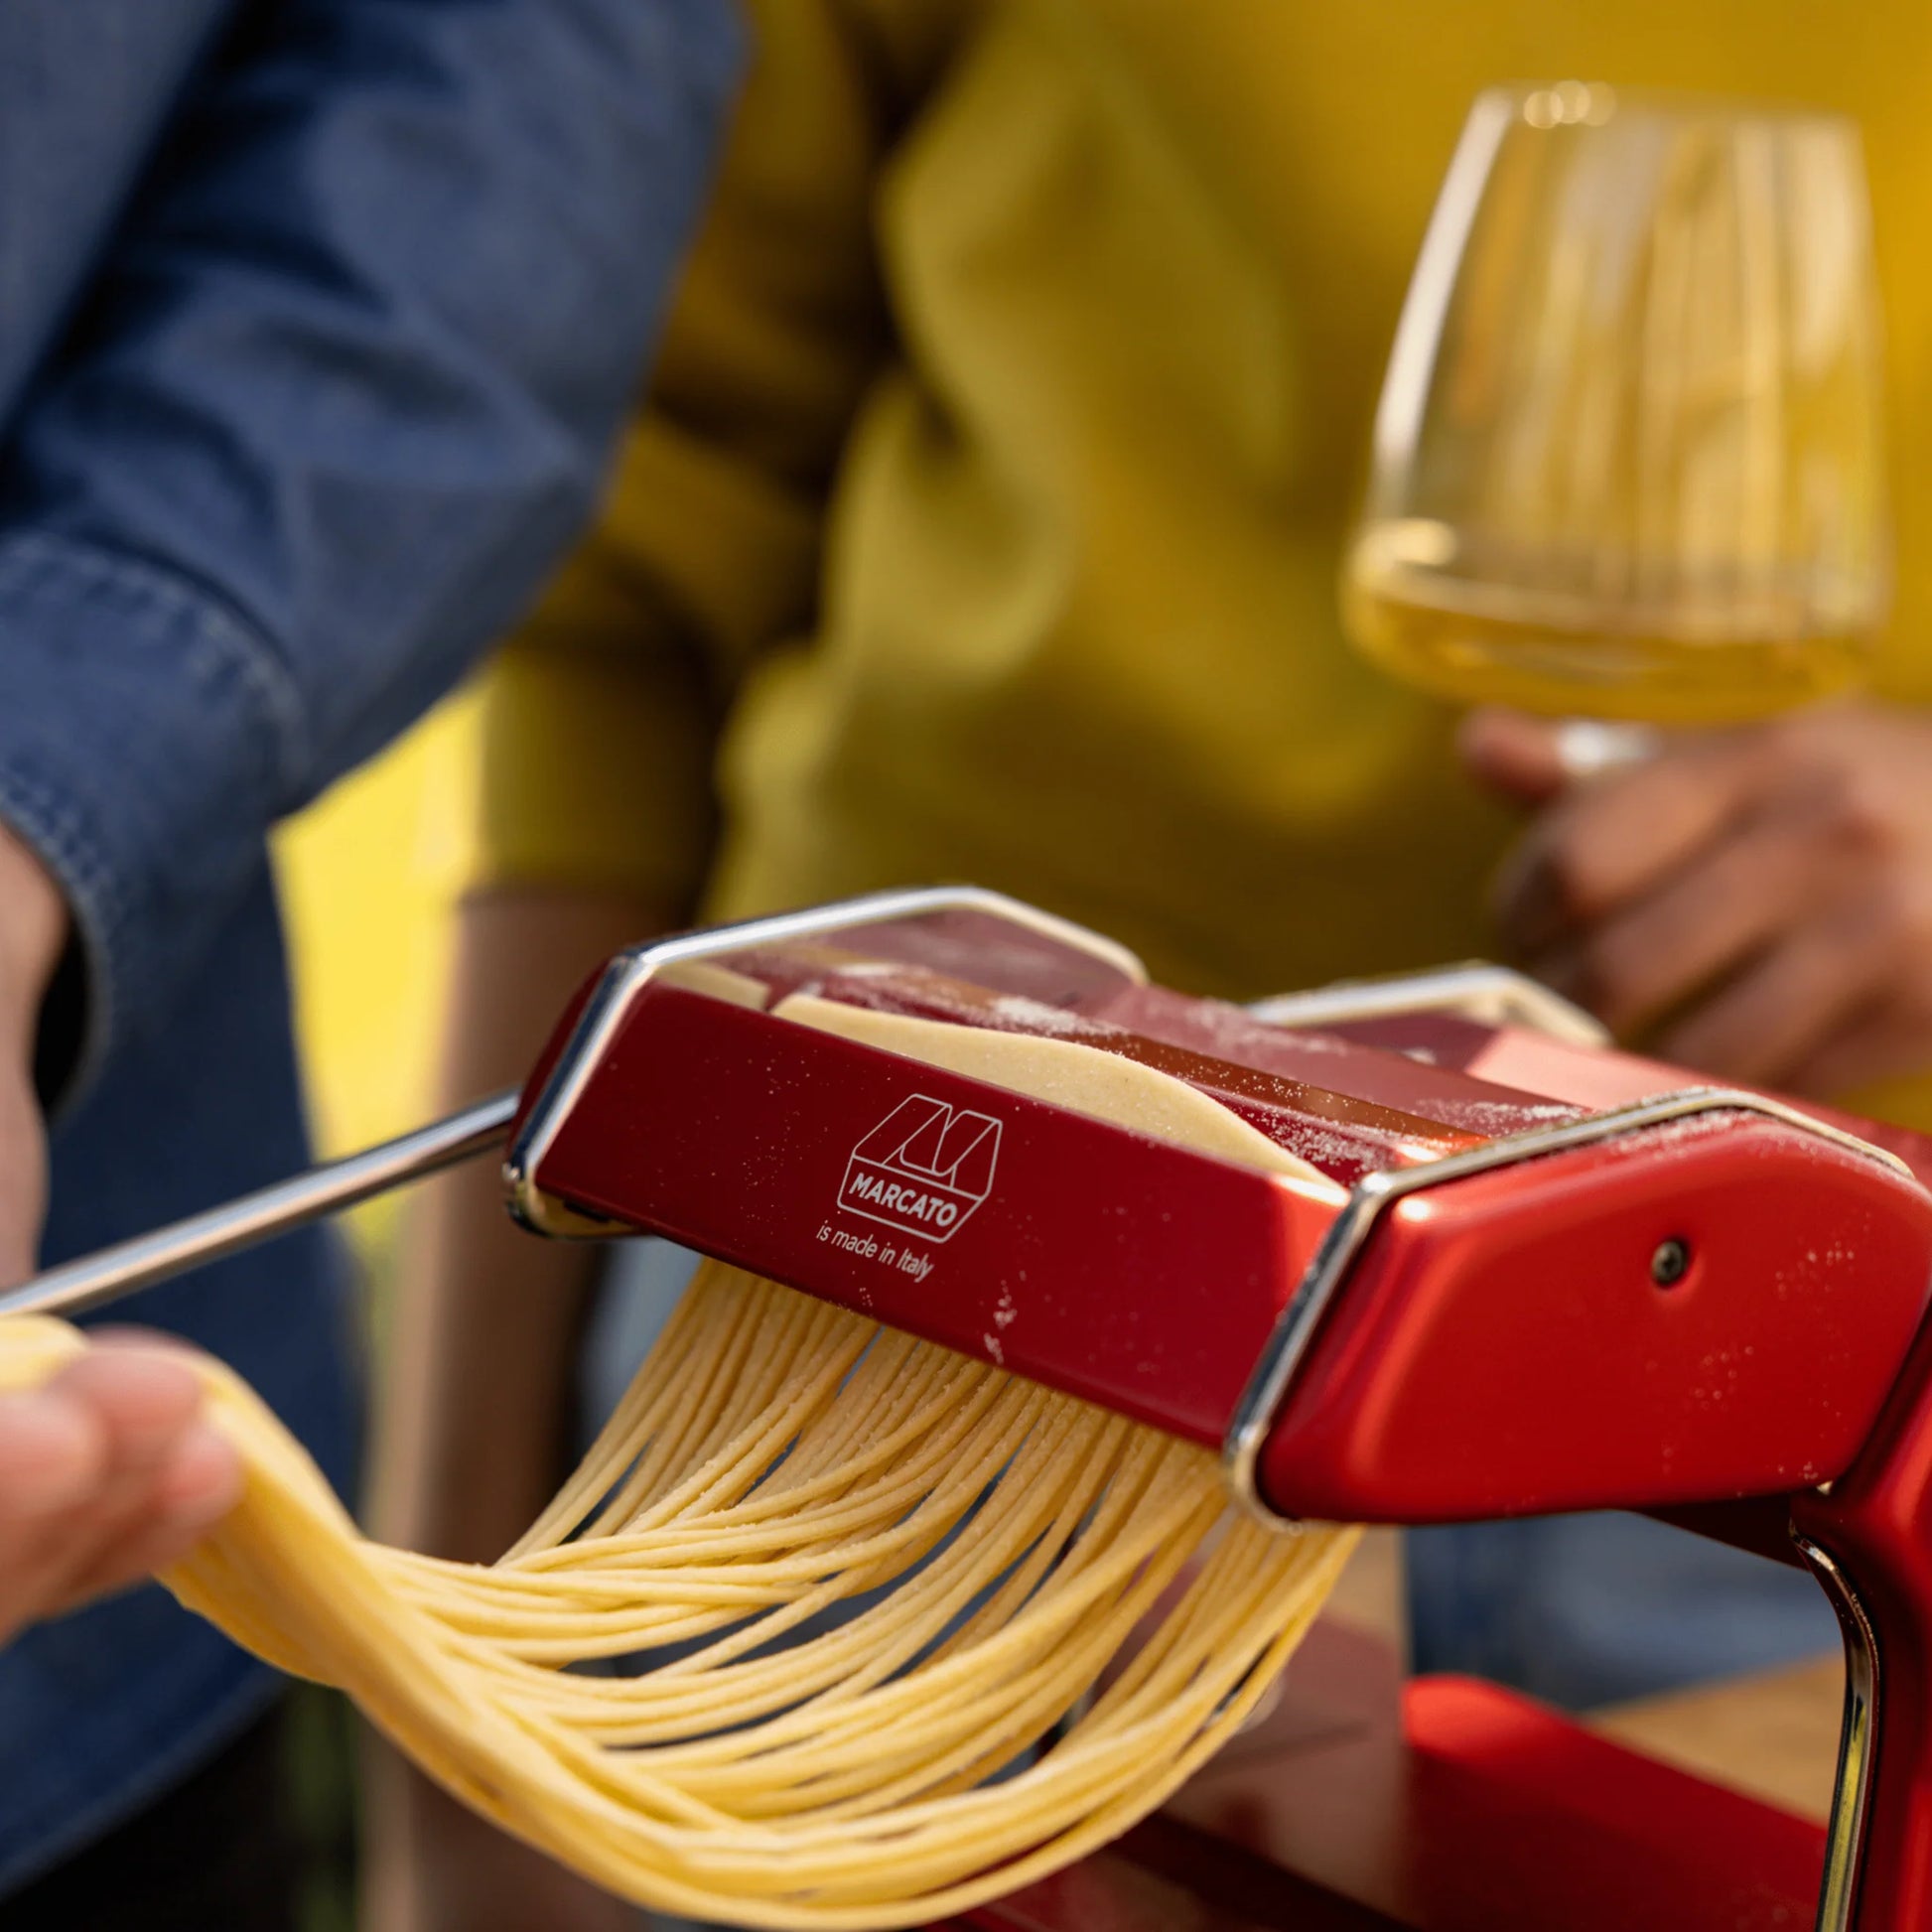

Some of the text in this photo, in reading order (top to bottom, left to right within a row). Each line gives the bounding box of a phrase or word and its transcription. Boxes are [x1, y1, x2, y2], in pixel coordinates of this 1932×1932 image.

[848, 1173, 958, 1226] MARCATO
[816, 1219, 934, 1283] is made in Italy
